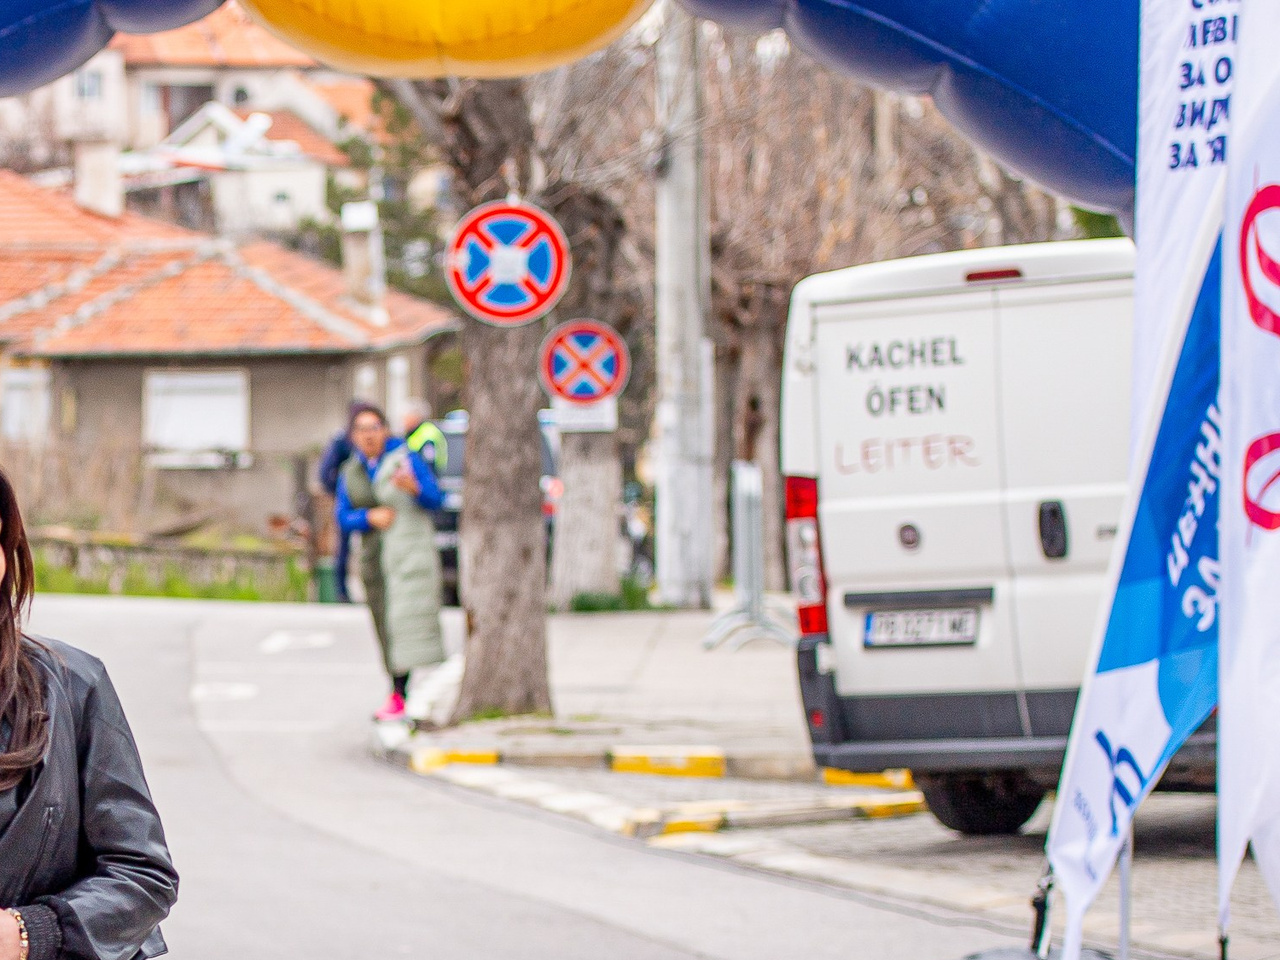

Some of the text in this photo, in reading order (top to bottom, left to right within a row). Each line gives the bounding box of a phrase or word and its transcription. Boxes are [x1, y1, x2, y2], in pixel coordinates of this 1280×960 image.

[845, 337, 966, 372] KACHEL
[865, 383, 947, 417] ÖFEN
[833, 433, 983, 476] LEITER
